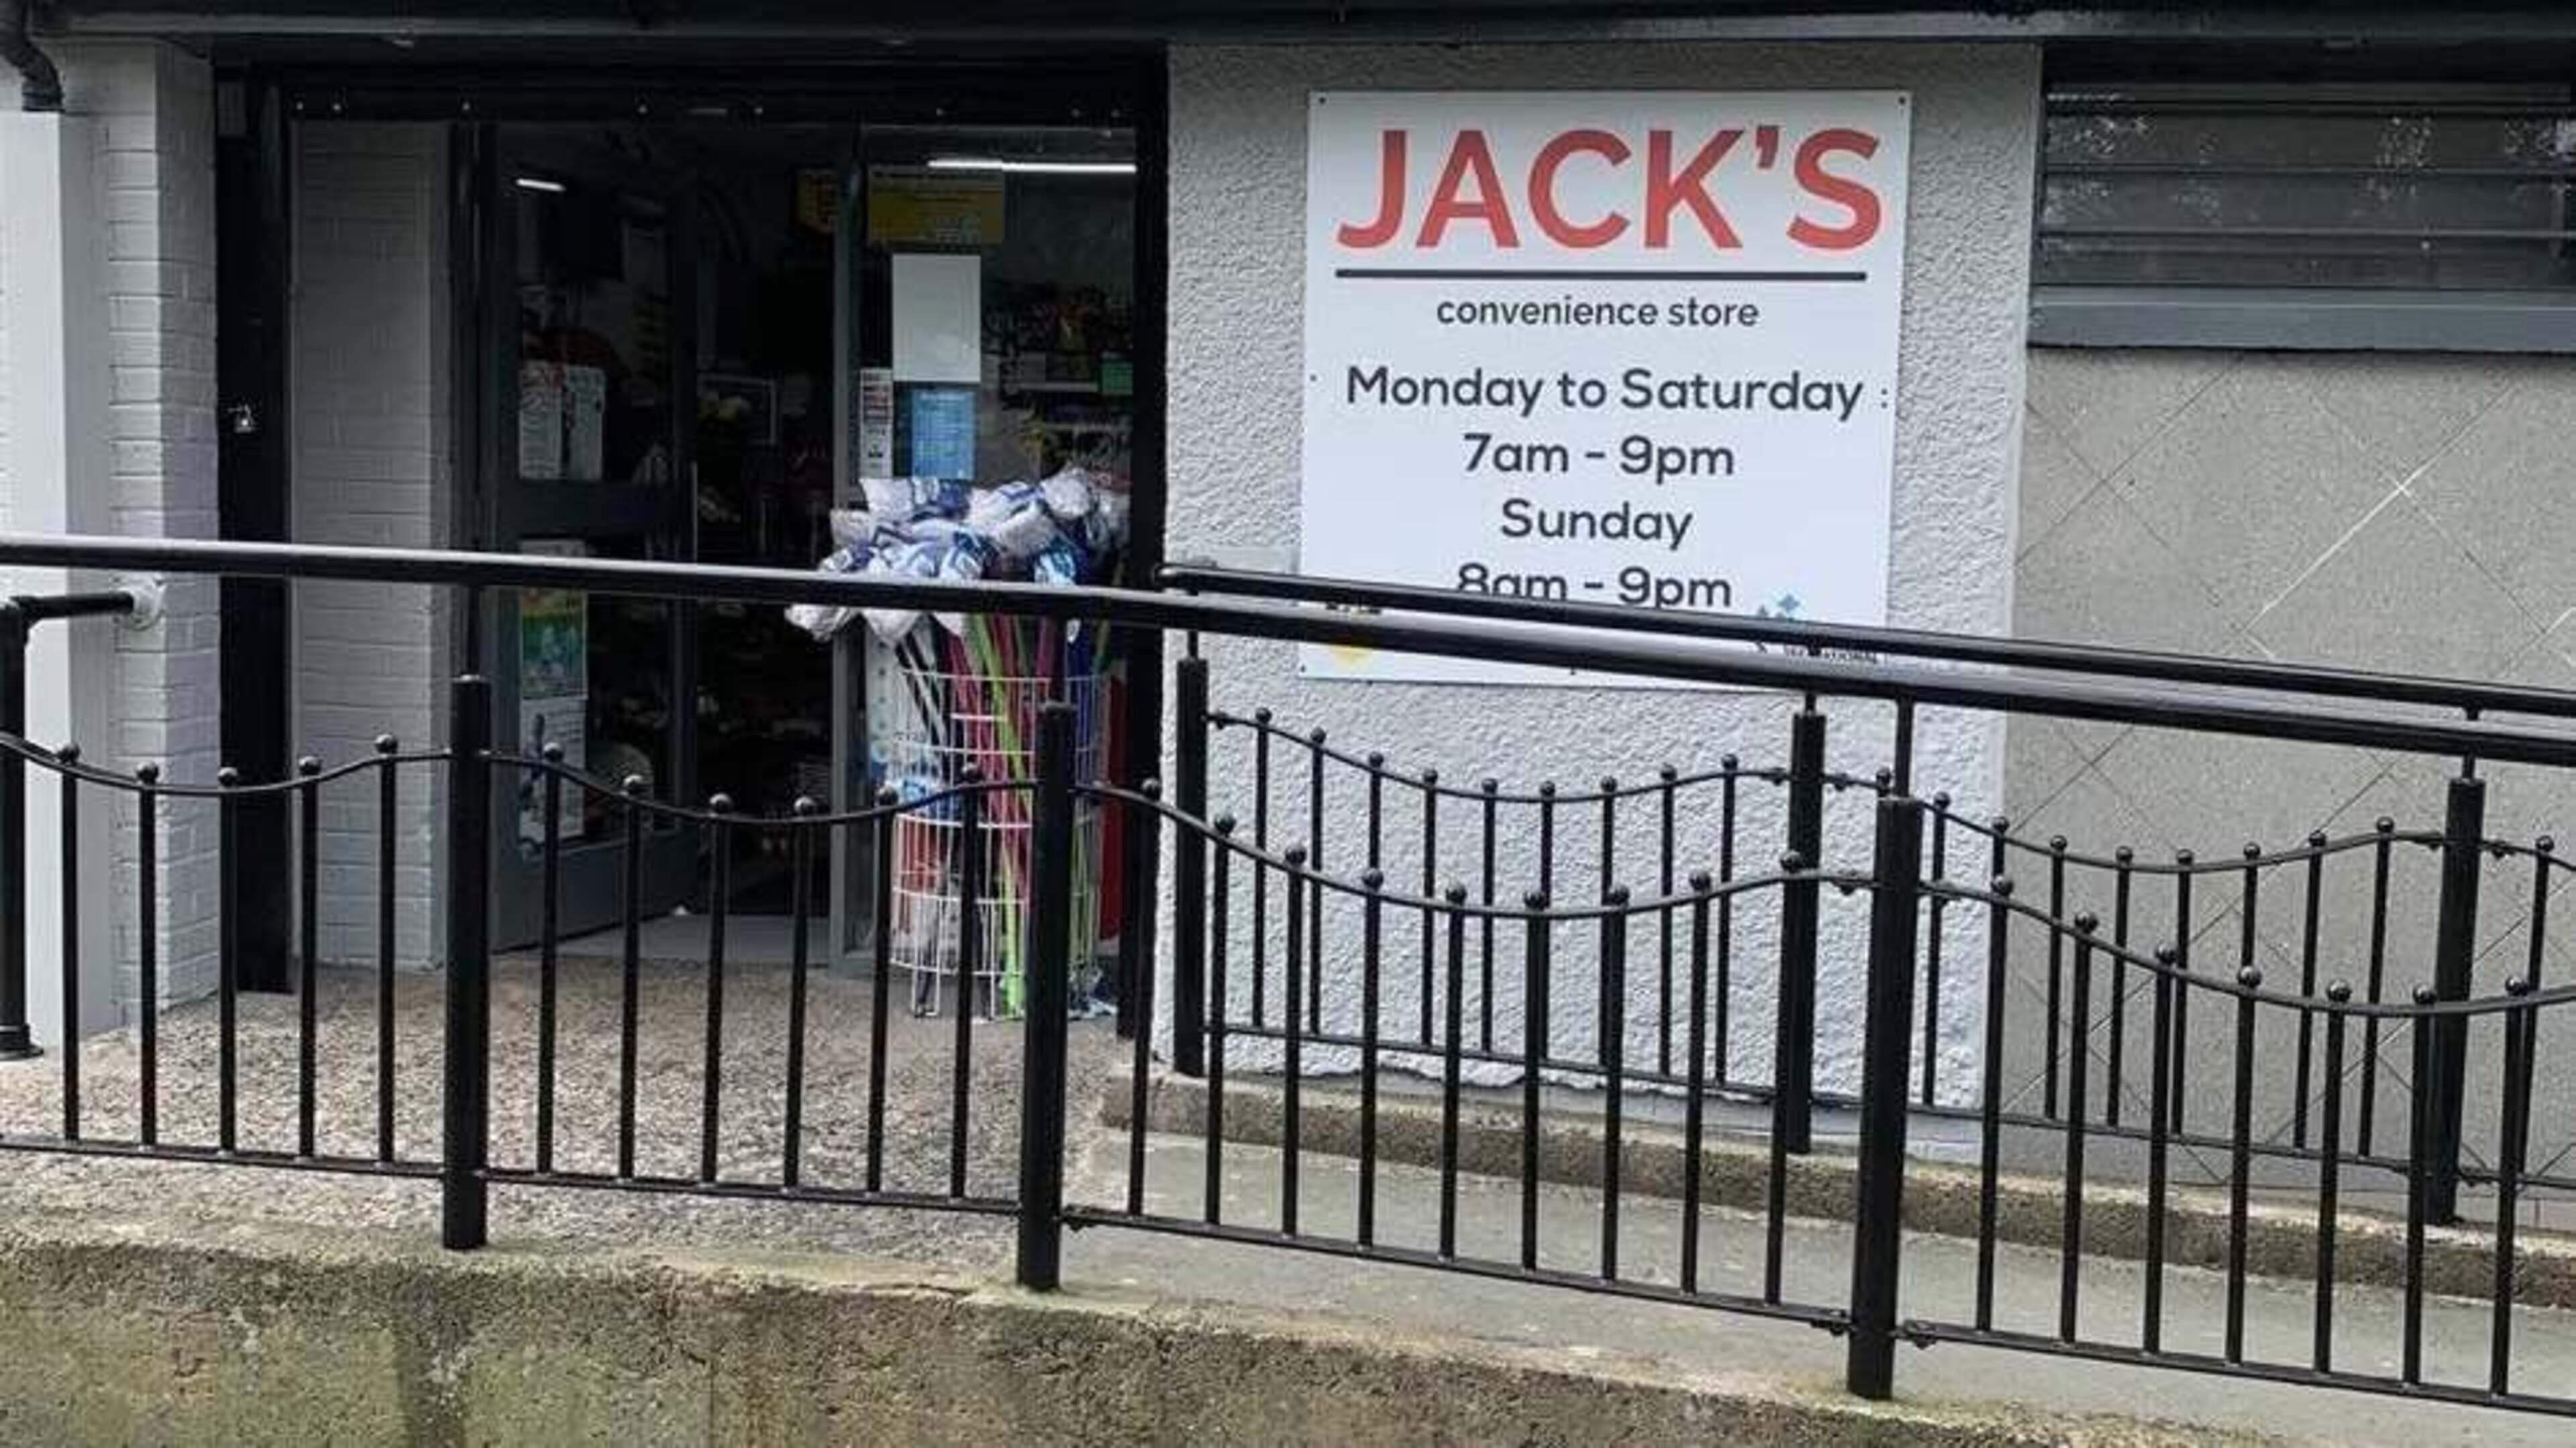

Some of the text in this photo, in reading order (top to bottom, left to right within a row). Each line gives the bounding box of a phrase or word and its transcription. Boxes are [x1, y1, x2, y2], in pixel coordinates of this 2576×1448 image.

[1336, 125, 1882, 250] JACK'S
[1436, 294, 1760, 327] convenience store
[1347, 366, 1864, 422] Monday to Saturday
[1463, 433, 1570, 474] 7am
[1619, 435, 1734, 484] 9pm
[1501, 498, 1693, 550] Sunday
[1458, 563, 1567, 600] 8am
[1618, 566, 1731, 608] 9pm
